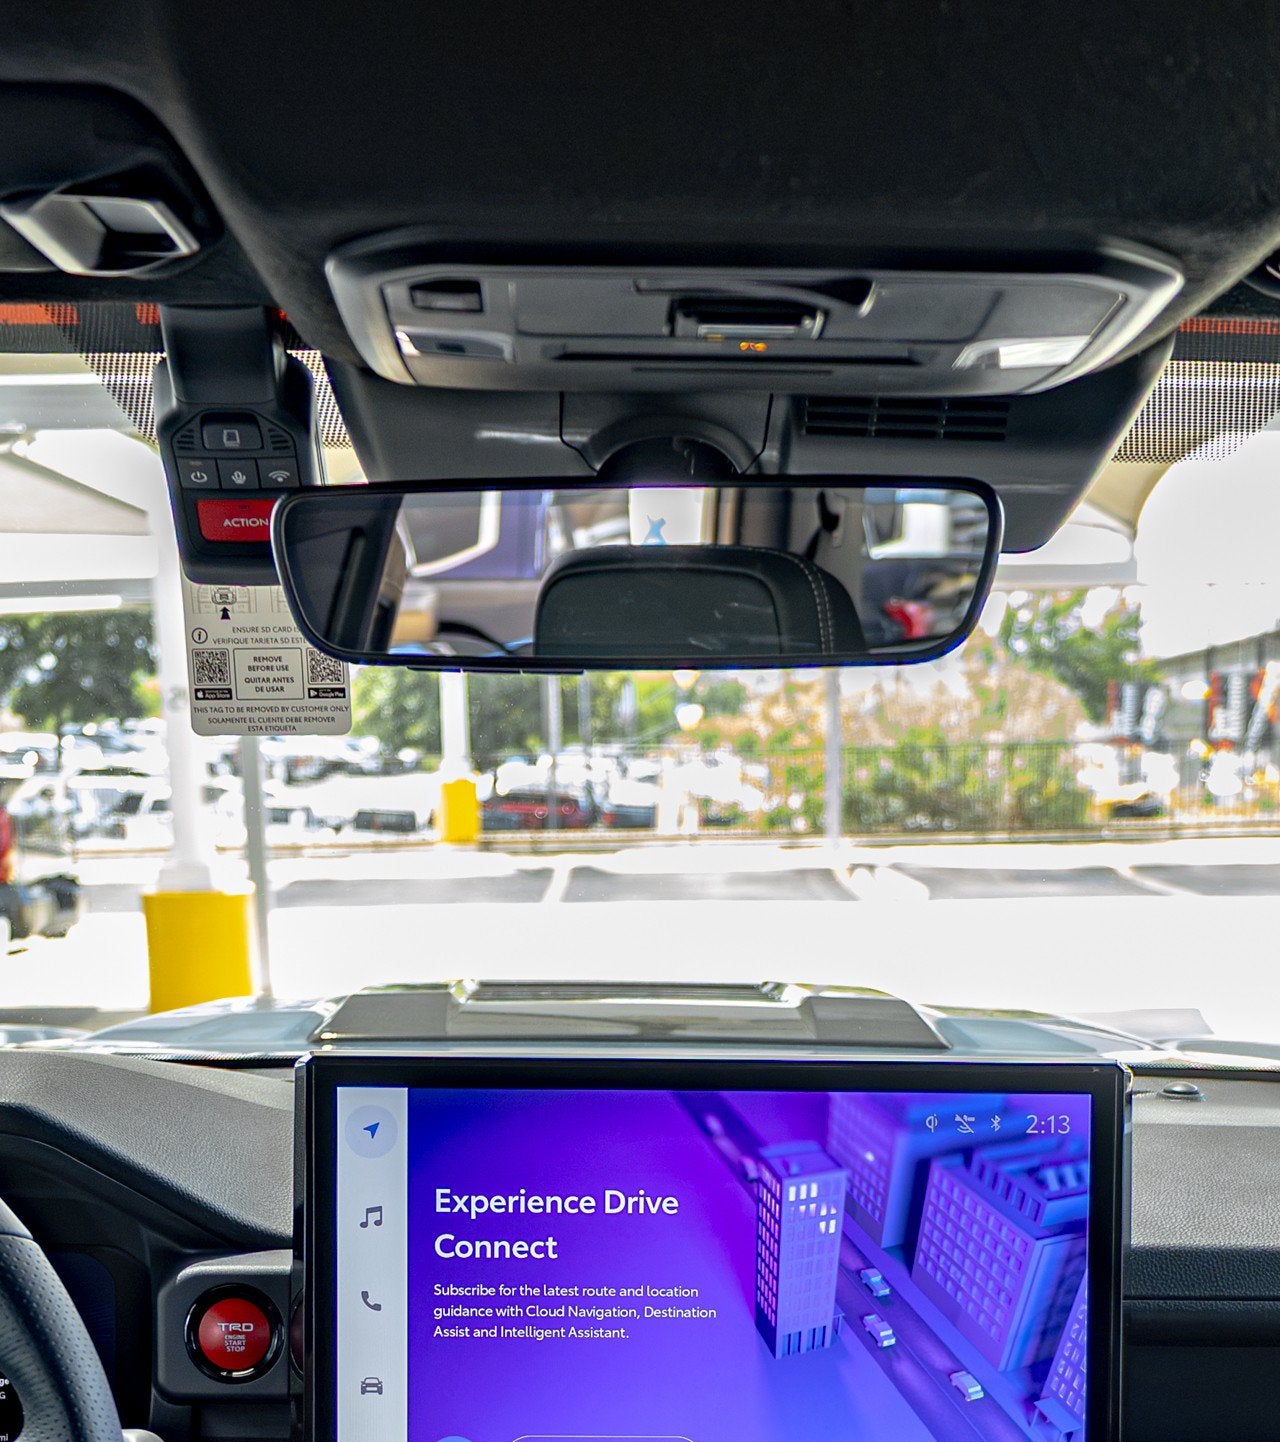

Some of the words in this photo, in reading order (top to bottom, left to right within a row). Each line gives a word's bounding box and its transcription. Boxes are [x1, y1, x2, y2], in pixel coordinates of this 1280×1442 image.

[223, 518, 269, 527] ACTION
[1025, 1115, 1071, 1135] 2:13
[435, 1188, 596, 1220] Experience
[604, 1190, 679, 1214] Drive
[434, 1234, 558, 1259] Connect
[434, 1284, 496, 1296] Subscribe
[499, 1284, 516, 1296] for
[519, 1284, 541, 1296] the
[544, 1285, 579, 1297] latest
[582, 1286, 616, 1297] route
[619, 1286, 644, 1297] and
[646, 1286, 698, 1297] location
[434, 1305, 493, 1319] guidance
[496, 1306, 523, 1317] with
[526, 1306, 565, 1317] Cloud
[568, 1307, 641, 1320] Navigation,
[644, 1307, 717, 1318] Destination
[217, 1323, 253, 1332] TRD
[434, 1326, 470, 1338] Assist
[473, 1327, 498, 1338] and
[500, 1327, 566, 1340] Intelligent
[568, 1327, 629, 1338] Assistant.
